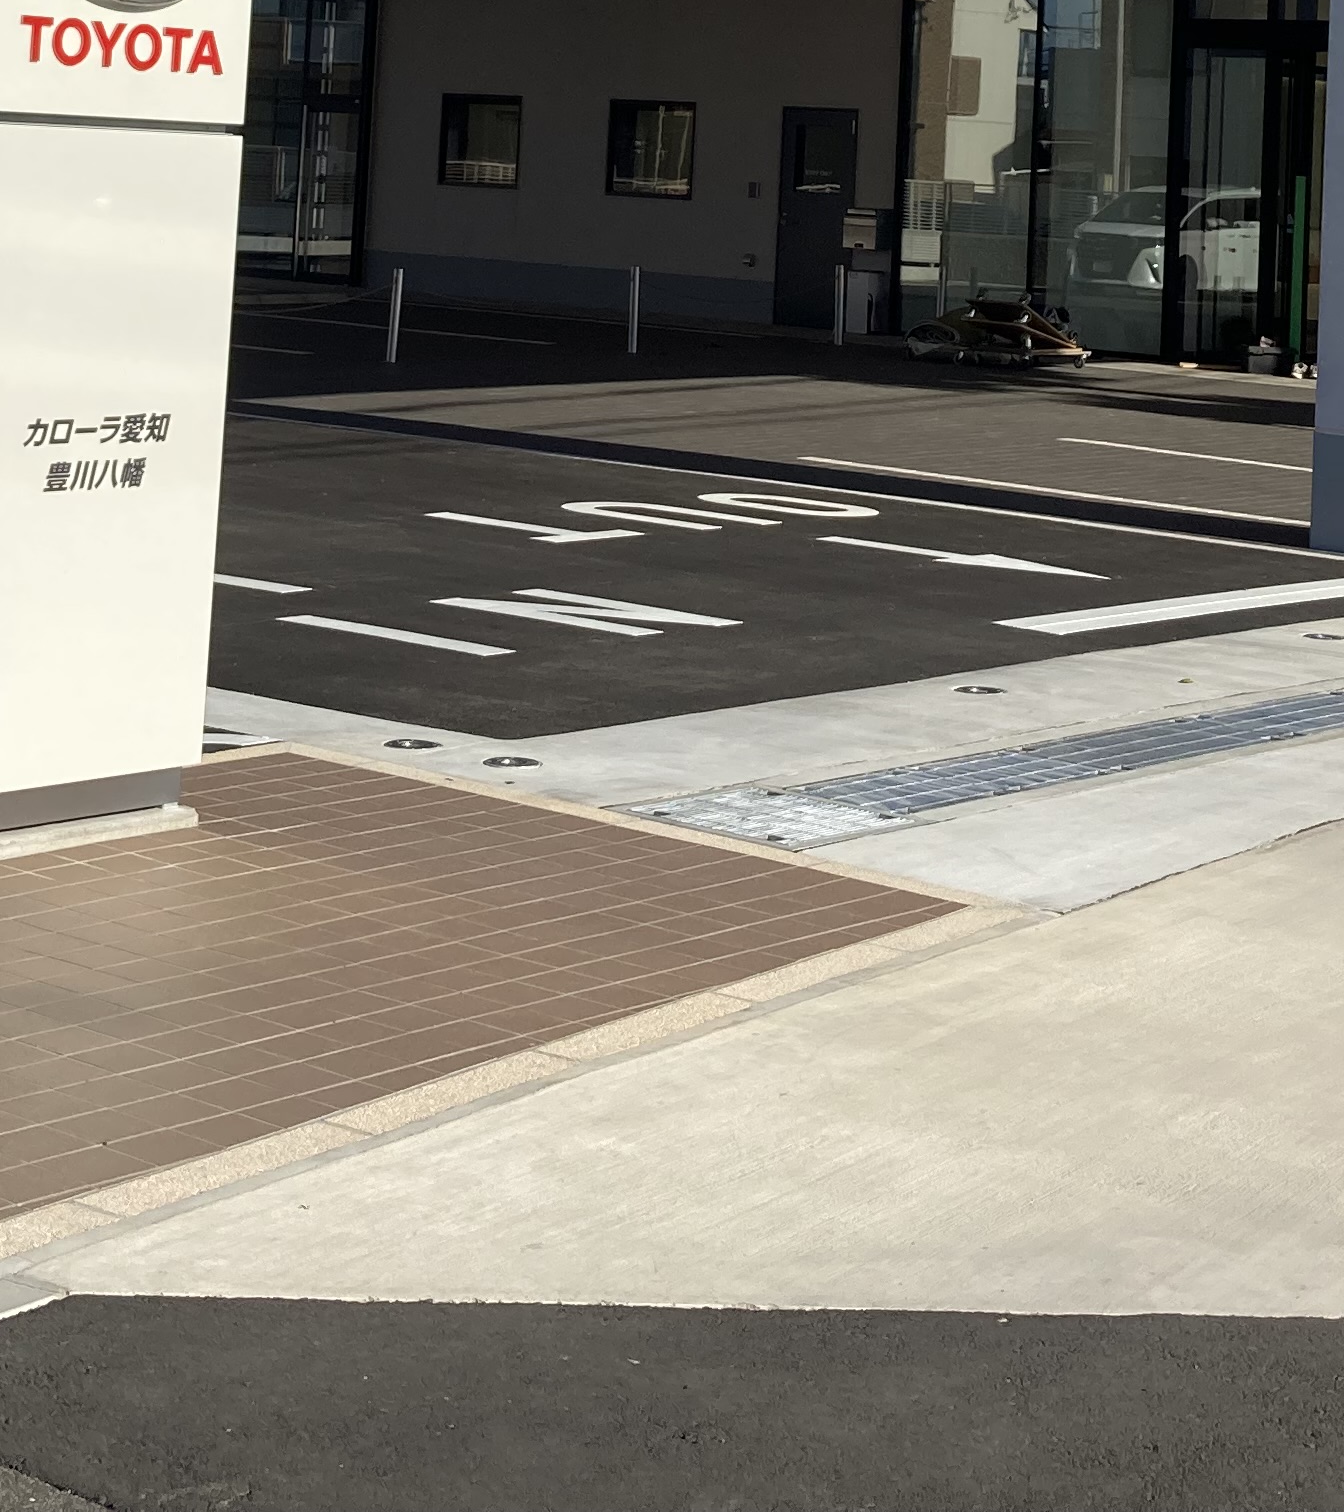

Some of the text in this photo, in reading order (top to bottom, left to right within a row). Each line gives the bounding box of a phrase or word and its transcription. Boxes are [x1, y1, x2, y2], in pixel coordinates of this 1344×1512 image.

[20, 14, 224, 76] TOYOTA
[23, 412, 171, 447] カローラ愛知
[43, 457, 147, 492] 豊川八幡
[275, 589, 743, 657] IN
